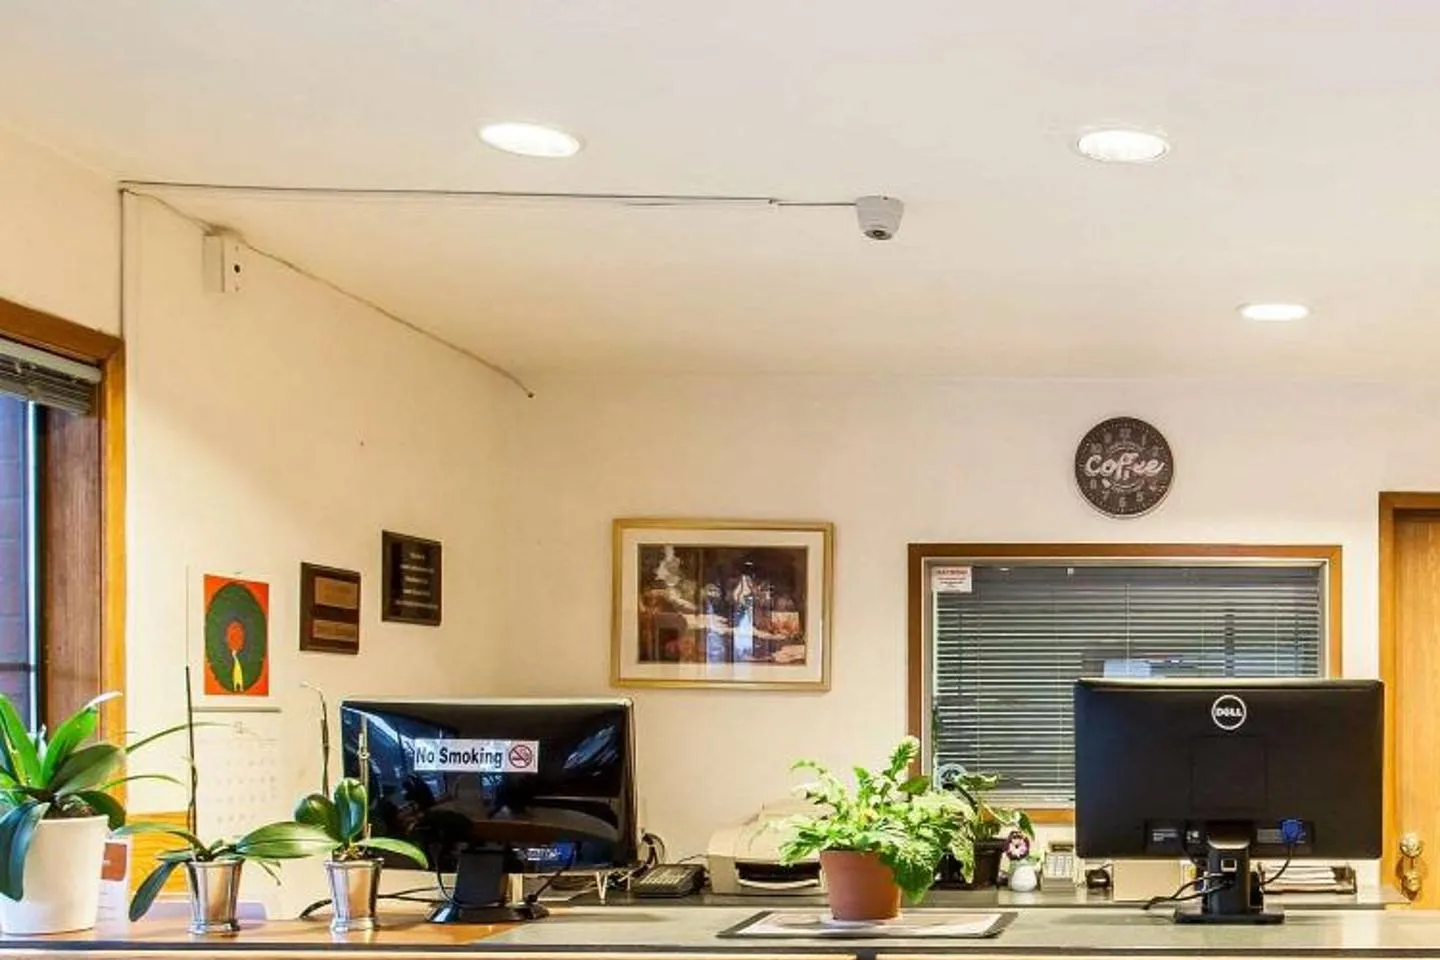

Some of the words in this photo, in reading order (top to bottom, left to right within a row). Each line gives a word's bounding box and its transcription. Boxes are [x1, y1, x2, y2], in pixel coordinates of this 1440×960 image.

[1084, 453, 1165, 481] Coffee
[1216, 706, 1244, 717] DELL
[416, 746, 435, 764] No
[440, 746, 503, 770] Smoking
